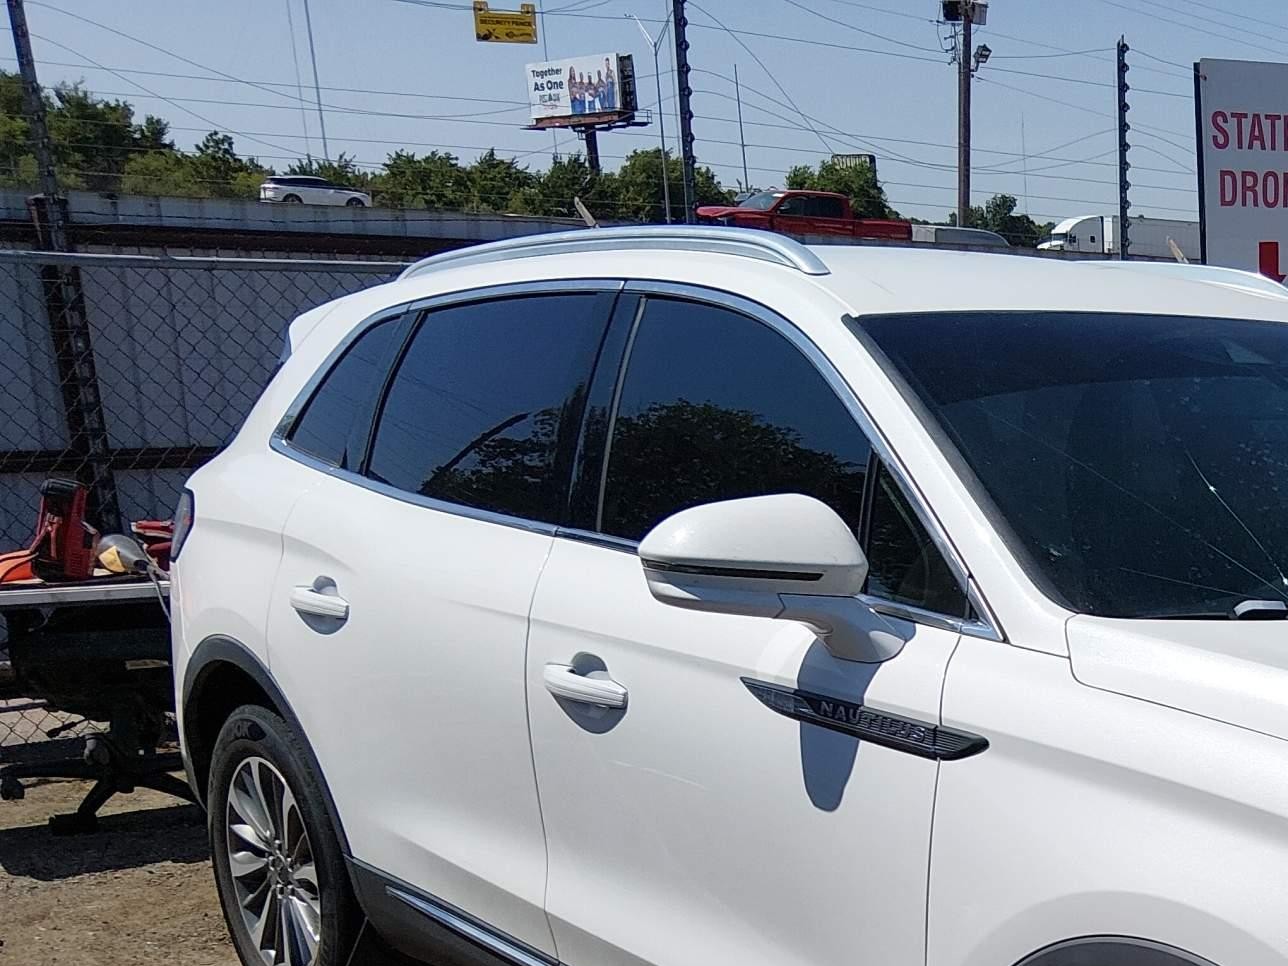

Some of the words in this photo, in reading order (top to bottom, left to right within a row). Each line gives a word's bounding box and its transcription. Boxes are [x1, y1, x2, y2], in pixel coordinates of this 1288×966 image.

[531, 67, 562, 79] Together
[533, 82, 545, 92] As
[546, 80, 564, 91] One
[819, 700, 927, 742] NAUTILUS
